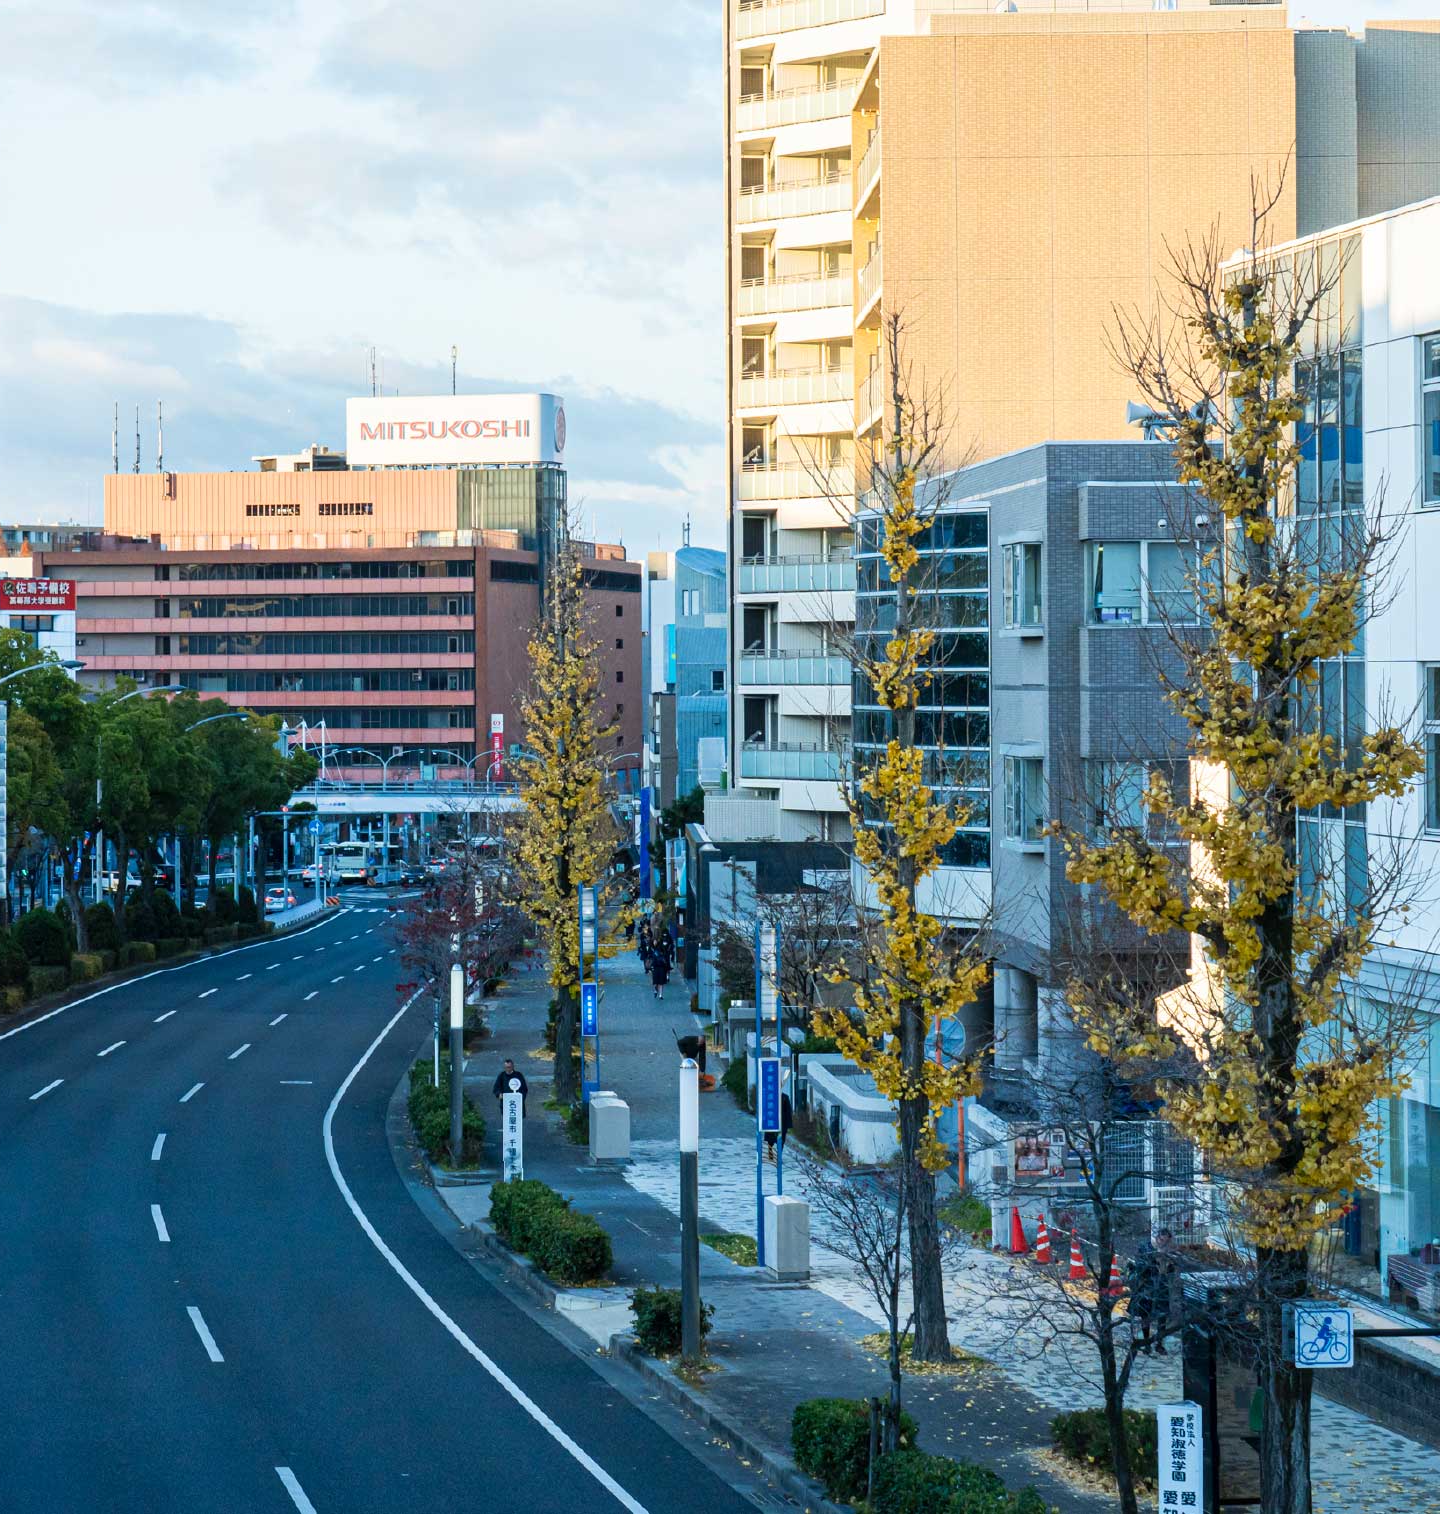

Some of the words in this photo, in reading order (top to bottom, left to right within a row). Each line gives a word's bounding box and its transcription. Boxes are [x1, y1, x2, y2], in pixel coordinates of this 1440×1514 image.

[360, 419, 530, 441] MITSUKOSHI
[508, 1099, 517, 1133] 名古屋市
[1186, 1413, 1196, 1448] 学校法人
[1170, 1416, 1186, 1482] 愛知淑徳学園
